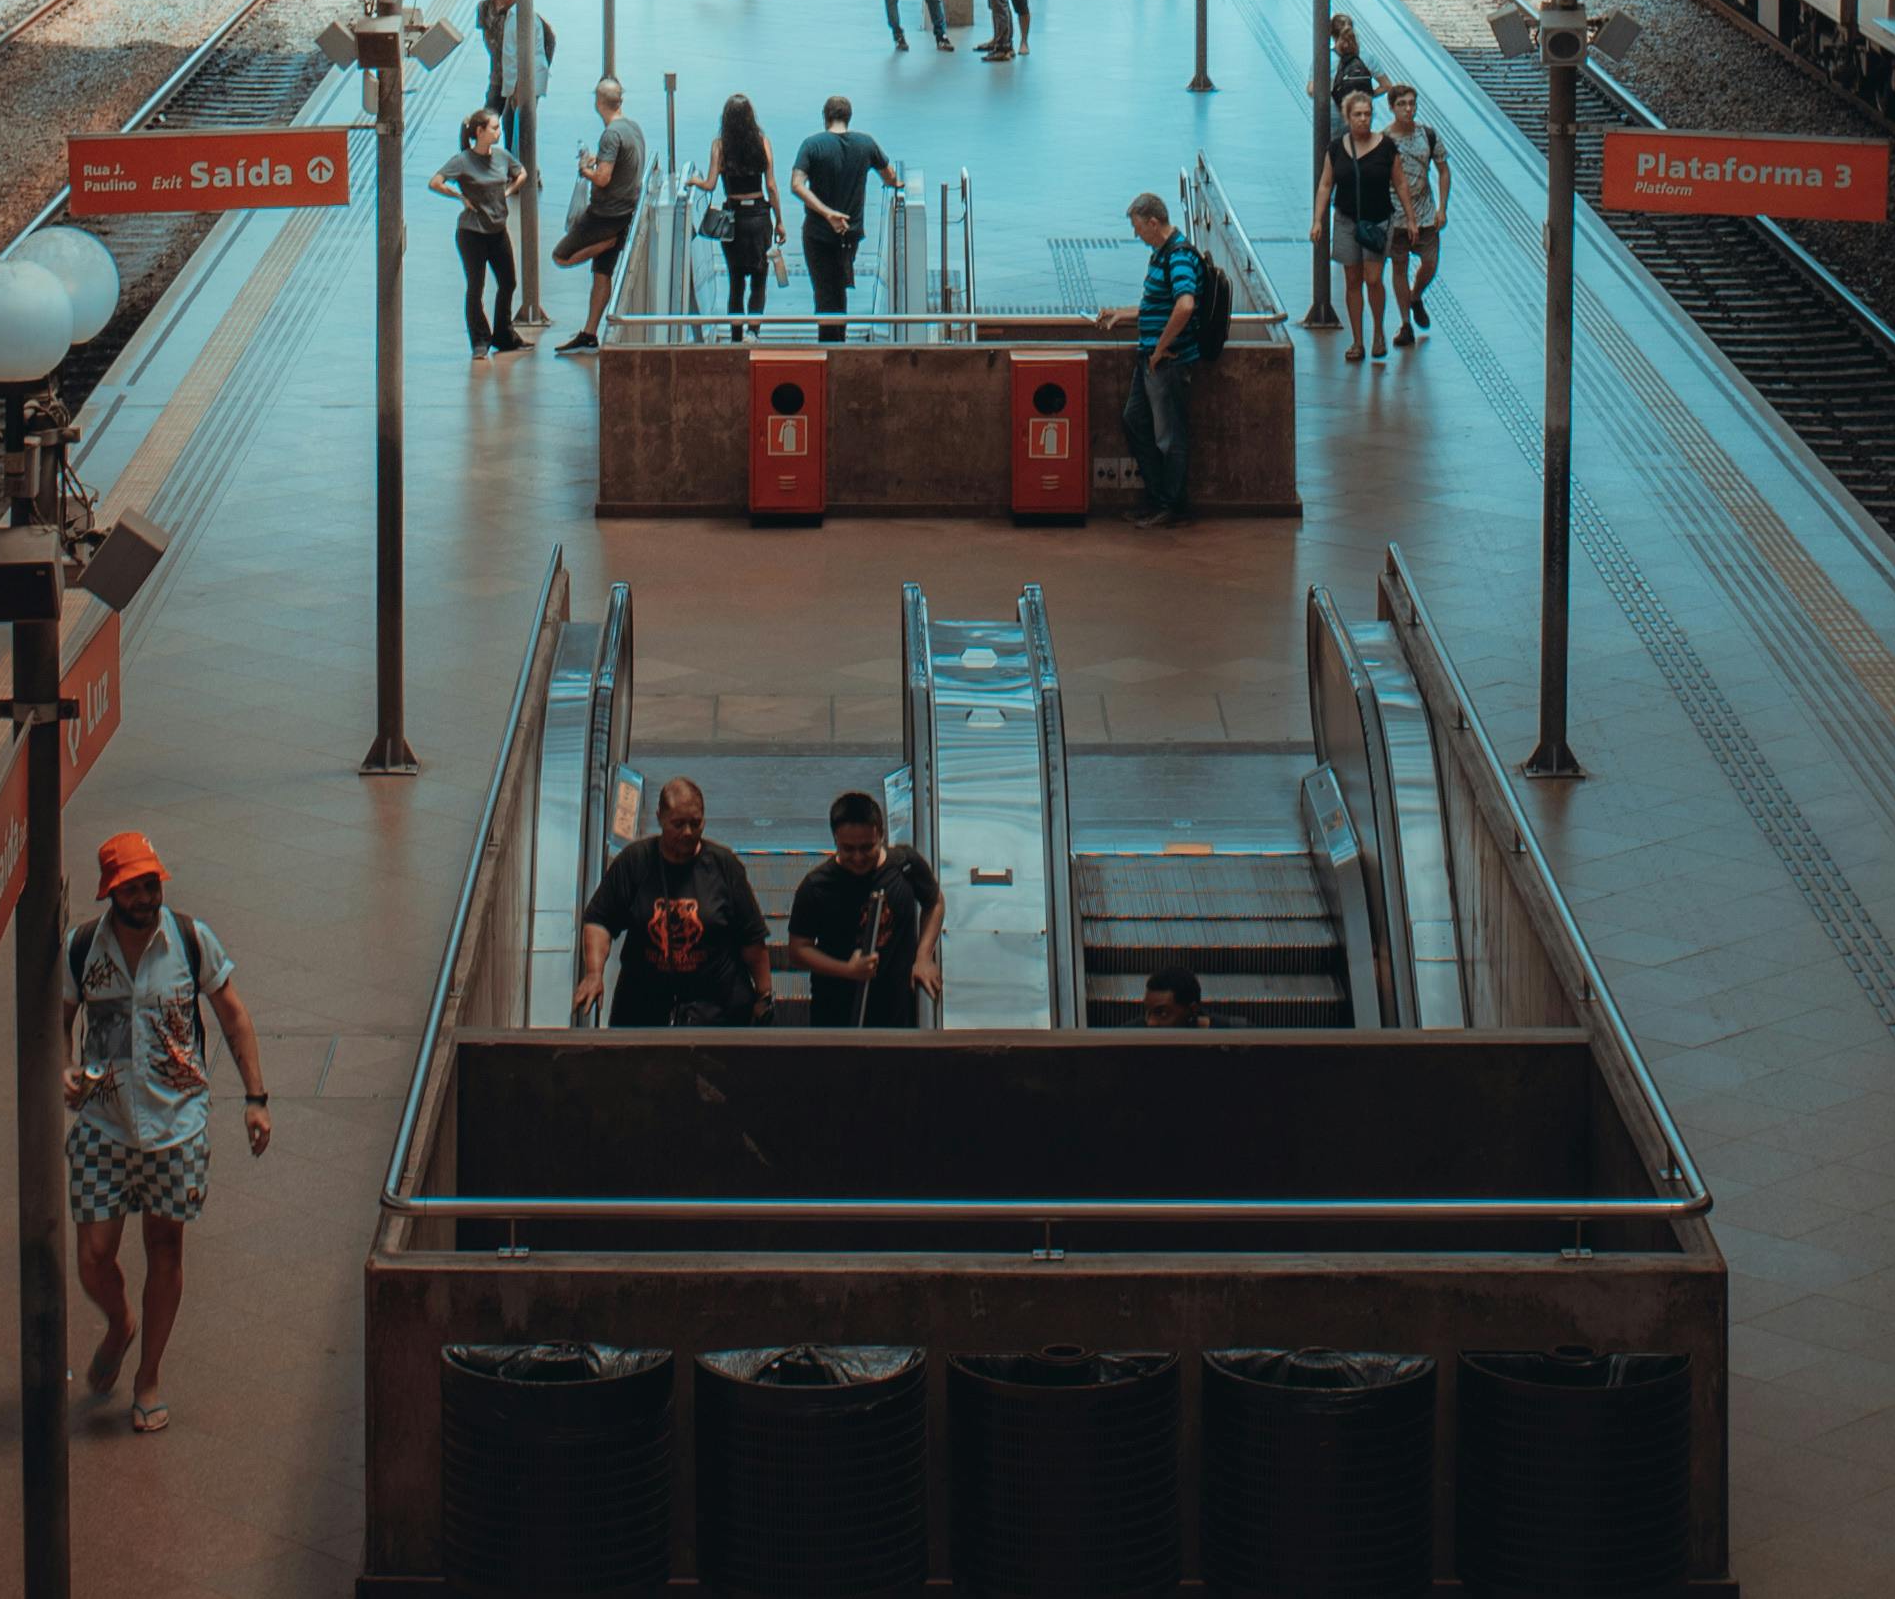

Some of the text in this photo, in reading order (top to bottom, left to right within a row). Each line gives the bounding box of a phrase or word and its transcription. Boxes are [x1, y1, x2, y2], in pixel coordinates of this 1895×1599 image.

[83, 163, 125, 177] Rua J.
[152, 157, 293, 191] Exit Saída
[1636, 153, 1852, 189] Plataforma 3
[83, 178, 137, 193] Paulino
[1634, 181, 1693, 197] Platform
[87, 670, 109, 736] Luz
